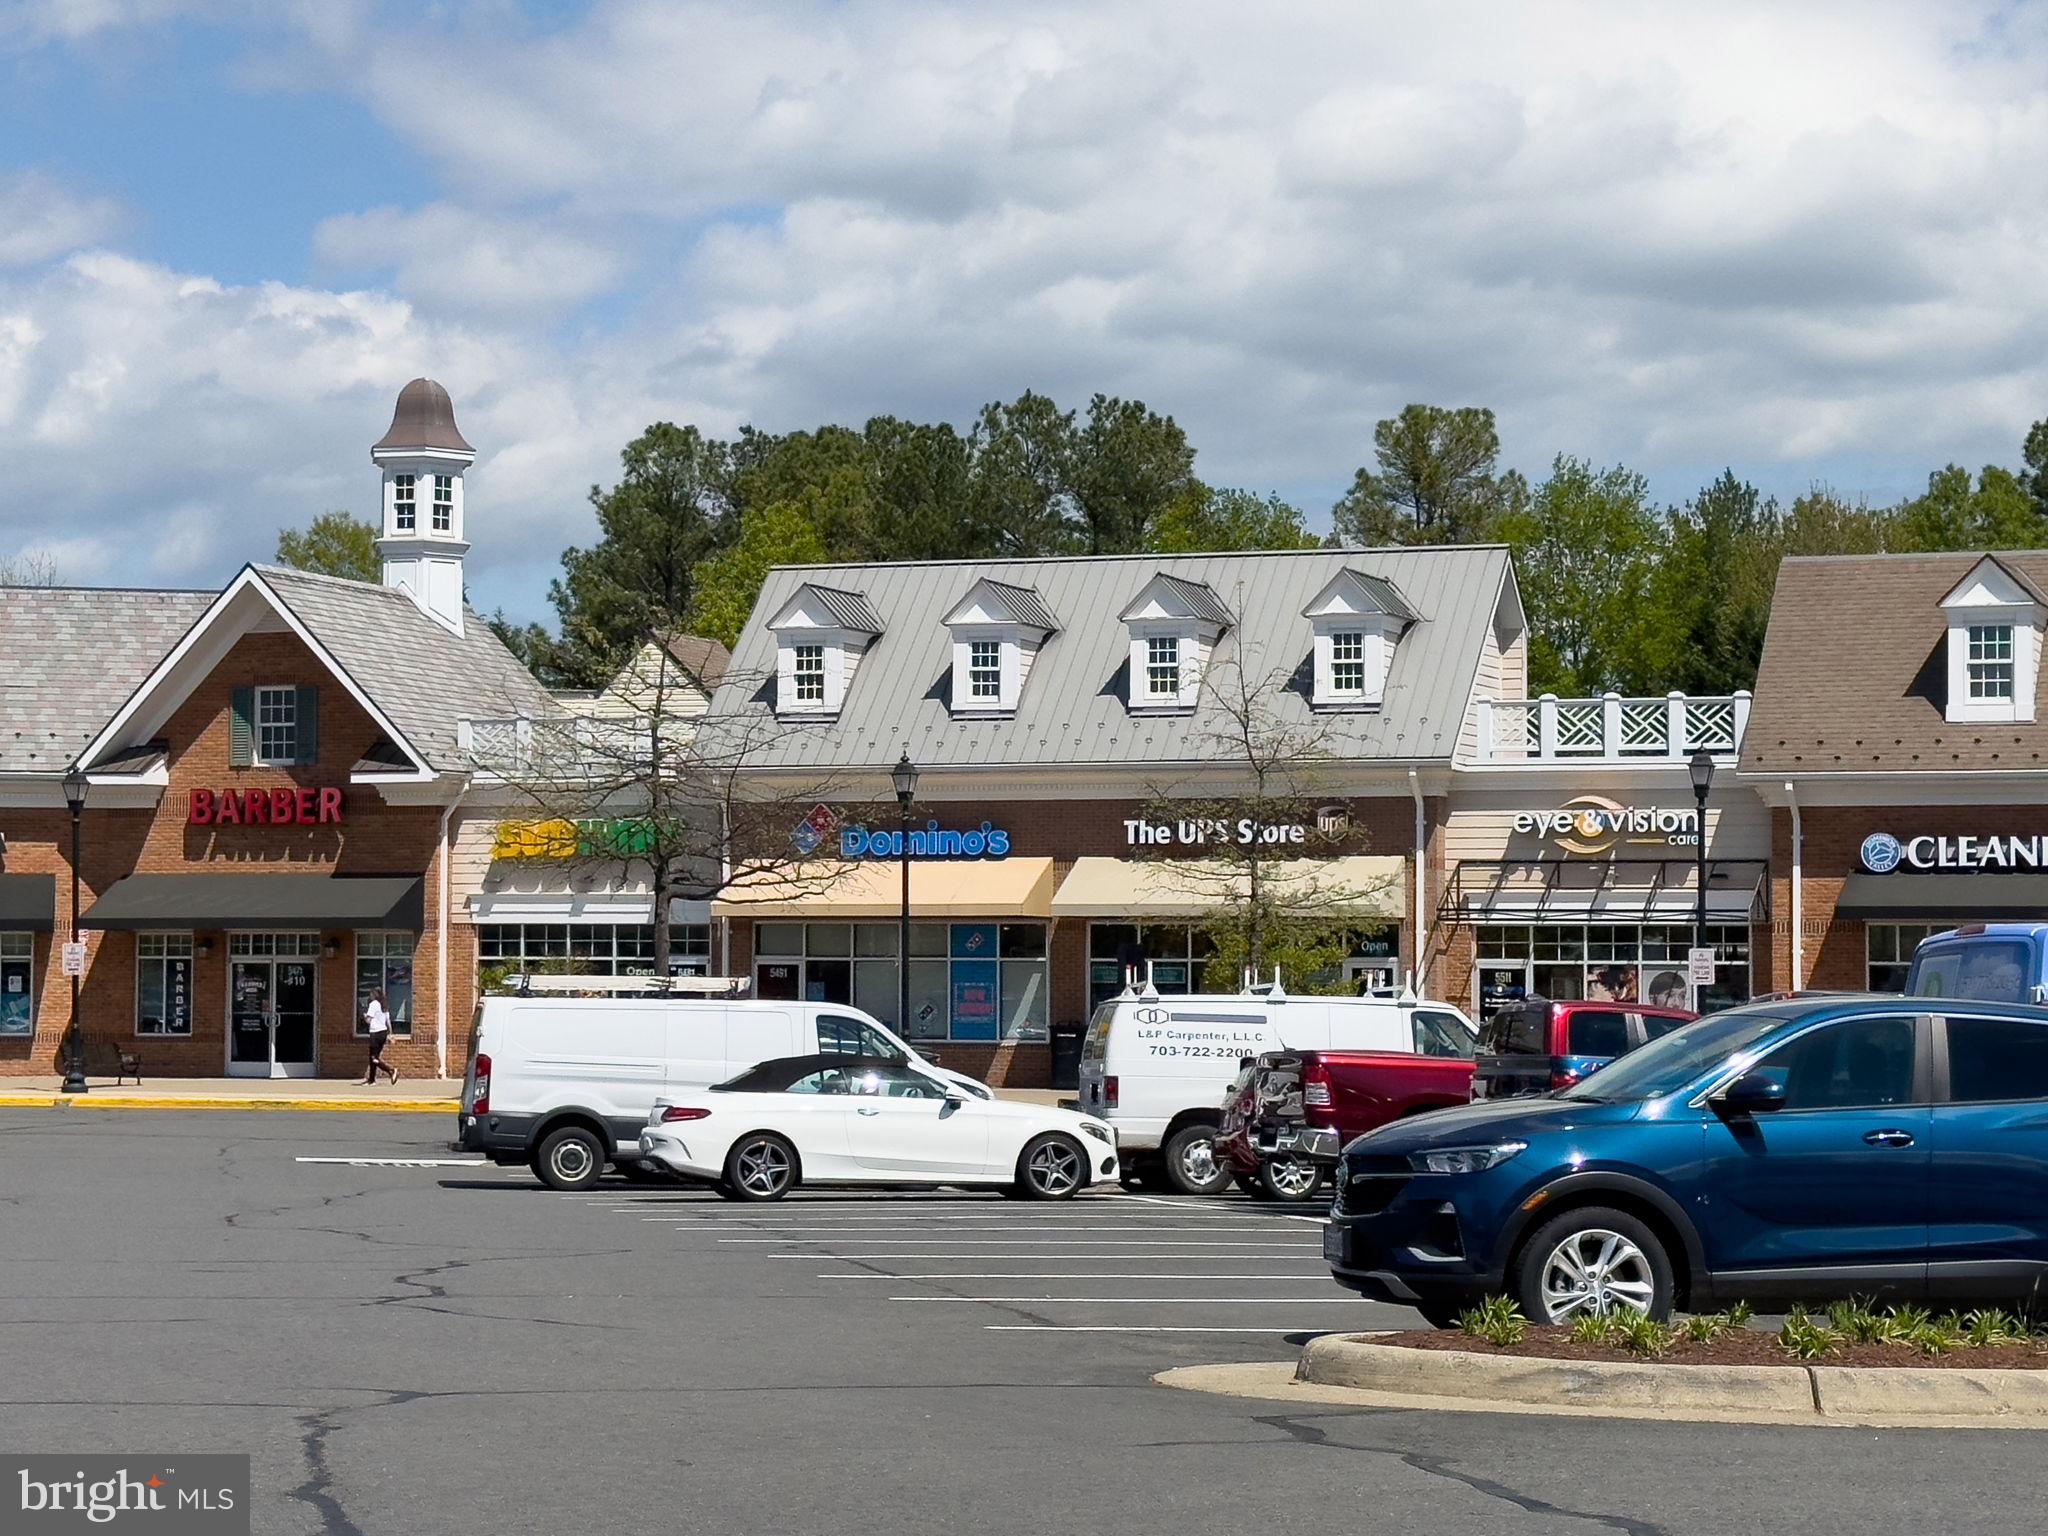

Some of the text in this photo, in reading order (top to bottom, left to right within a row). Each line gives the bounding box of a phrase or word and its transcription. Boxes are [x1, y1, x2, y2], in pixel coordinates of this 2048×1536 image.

[190, 787, 343, 825] BARBER
[840, 819, 1010, 857] Domino's
[1123, 819, 1171, 844] The
[1178, 818, 1230, 845] UPS
[1668, 834, 1699, 845] care
[1361, 940, 1389, 953] Open
[626, 966, 656, 976] Open
[1494, 971, 1512, 983] 5511
[175, 962, 185, 1027] BARBER
[1137, 1029, 1162, 1039] L&P
[1166, 1030, 1229, 1042] Carpenter,
[1149, 1045, 1253, 1059] 703-722-2200
